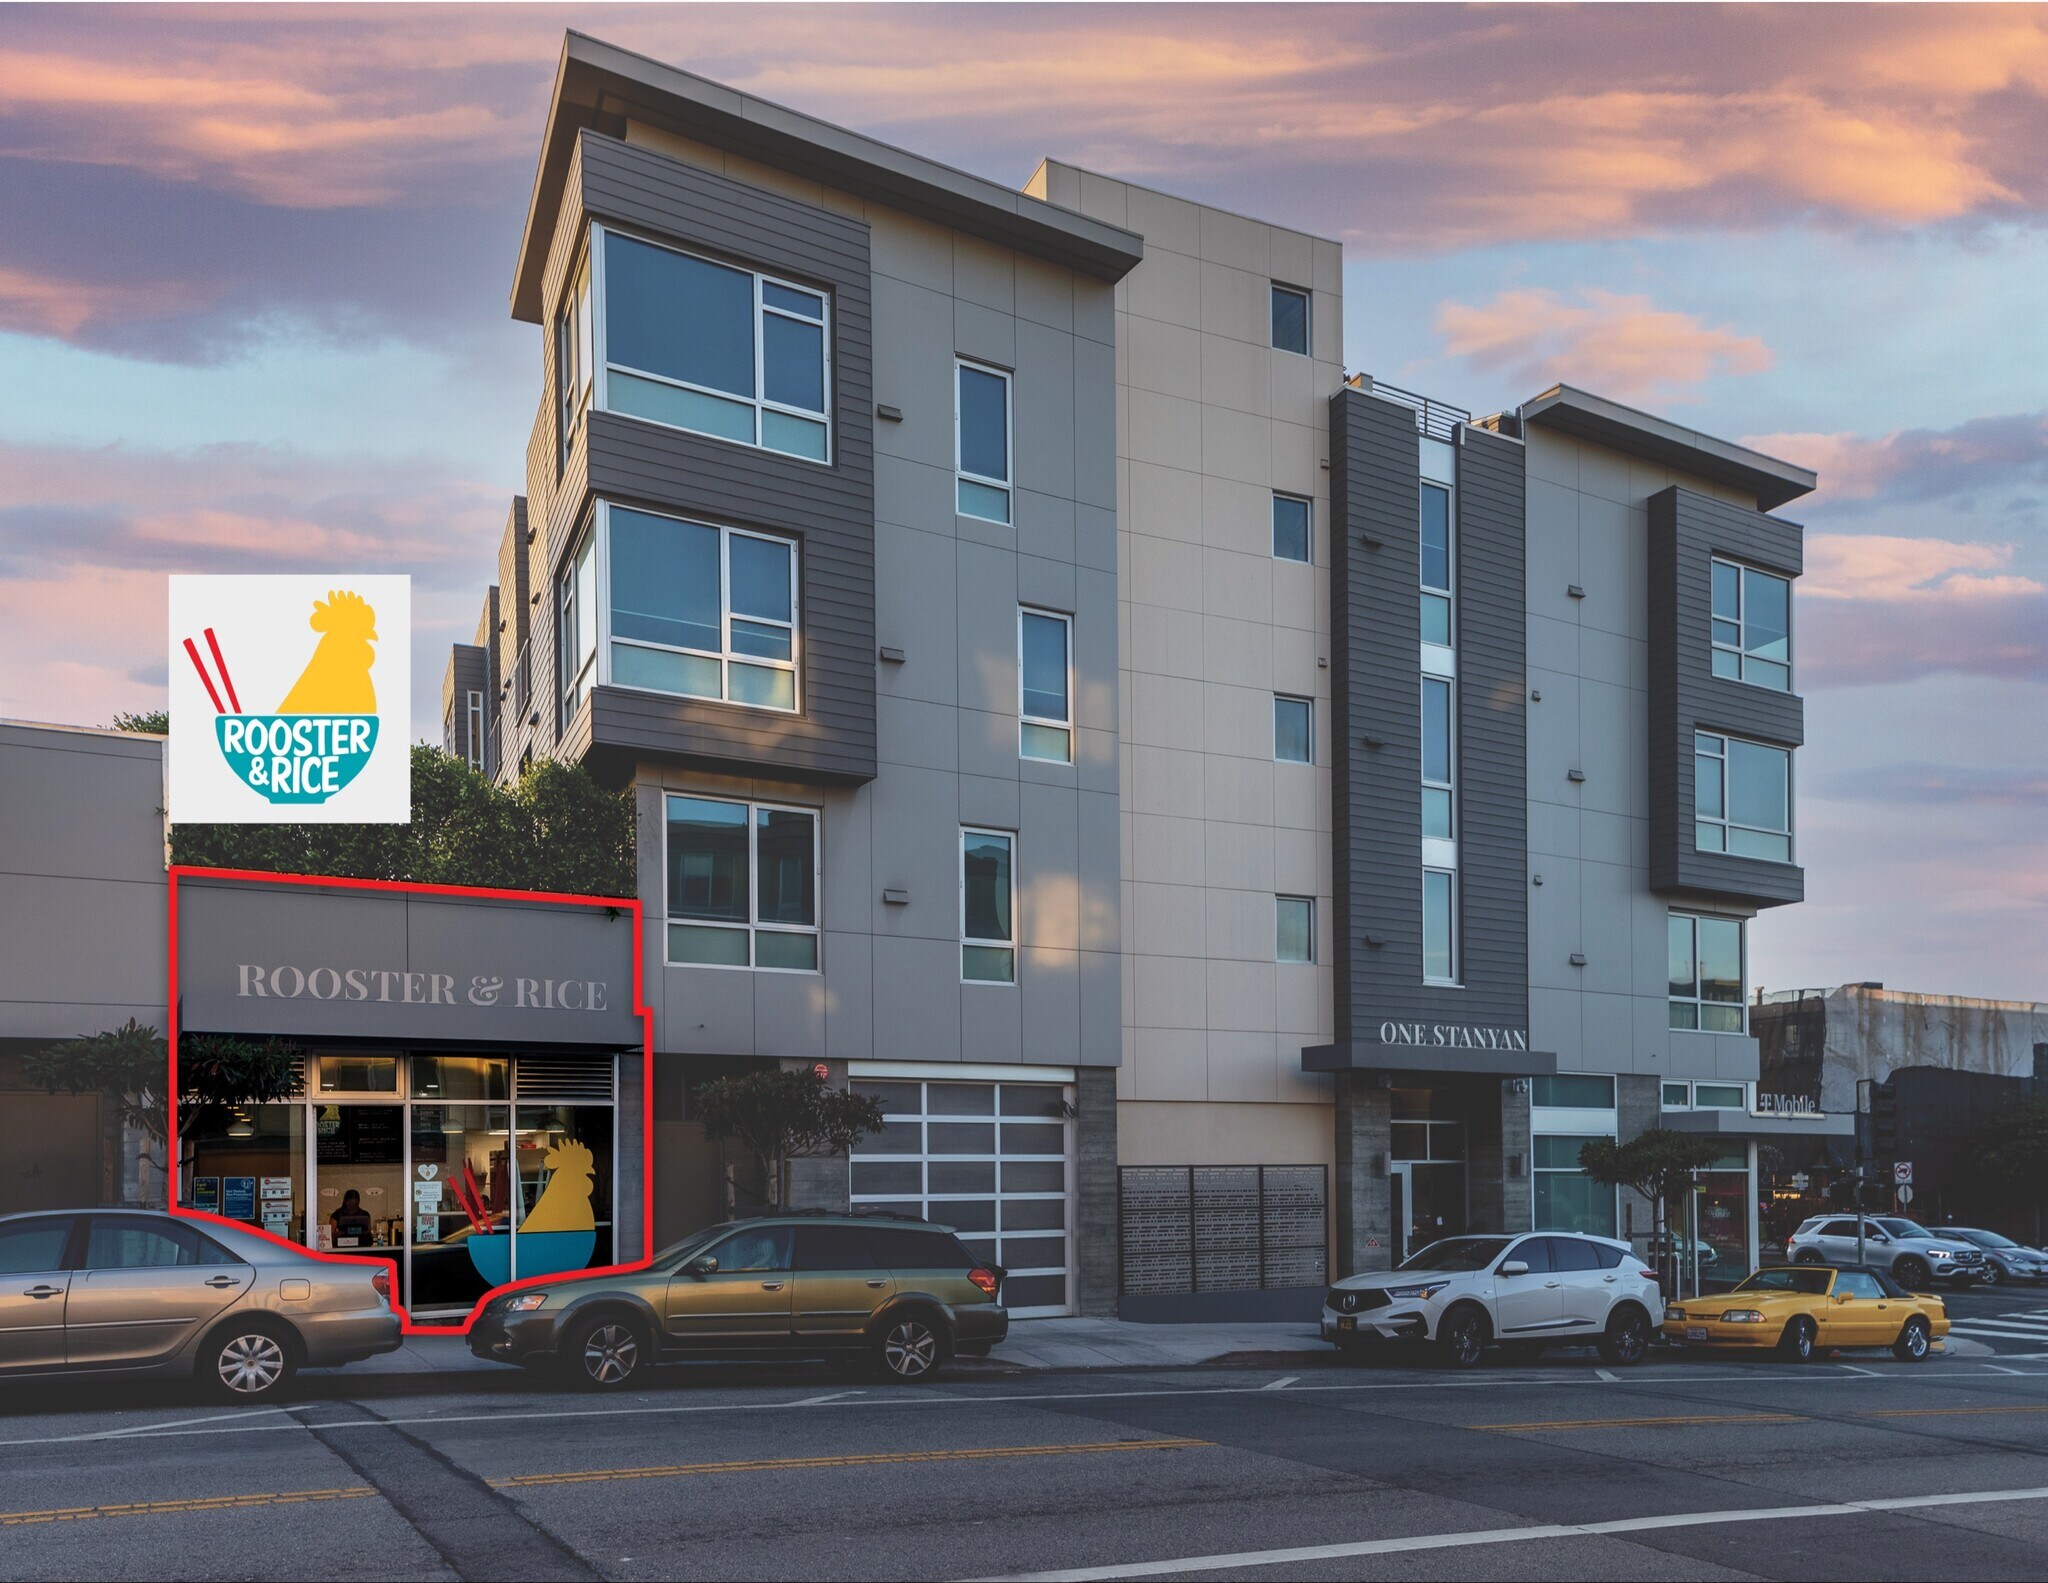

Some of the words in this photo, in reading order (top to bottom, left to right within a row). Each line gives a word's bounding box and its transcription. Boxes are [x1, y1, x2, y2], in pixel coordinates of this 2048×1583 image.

[237, 964, 456, 1004] ROOSTER
[468, 975, 504, 1006] &
[515, 977, 608, 1011] RICE
[1380, 1021, 1427, 1046] ONE
[1433, 1024, 1526, 1051] STANYAN
